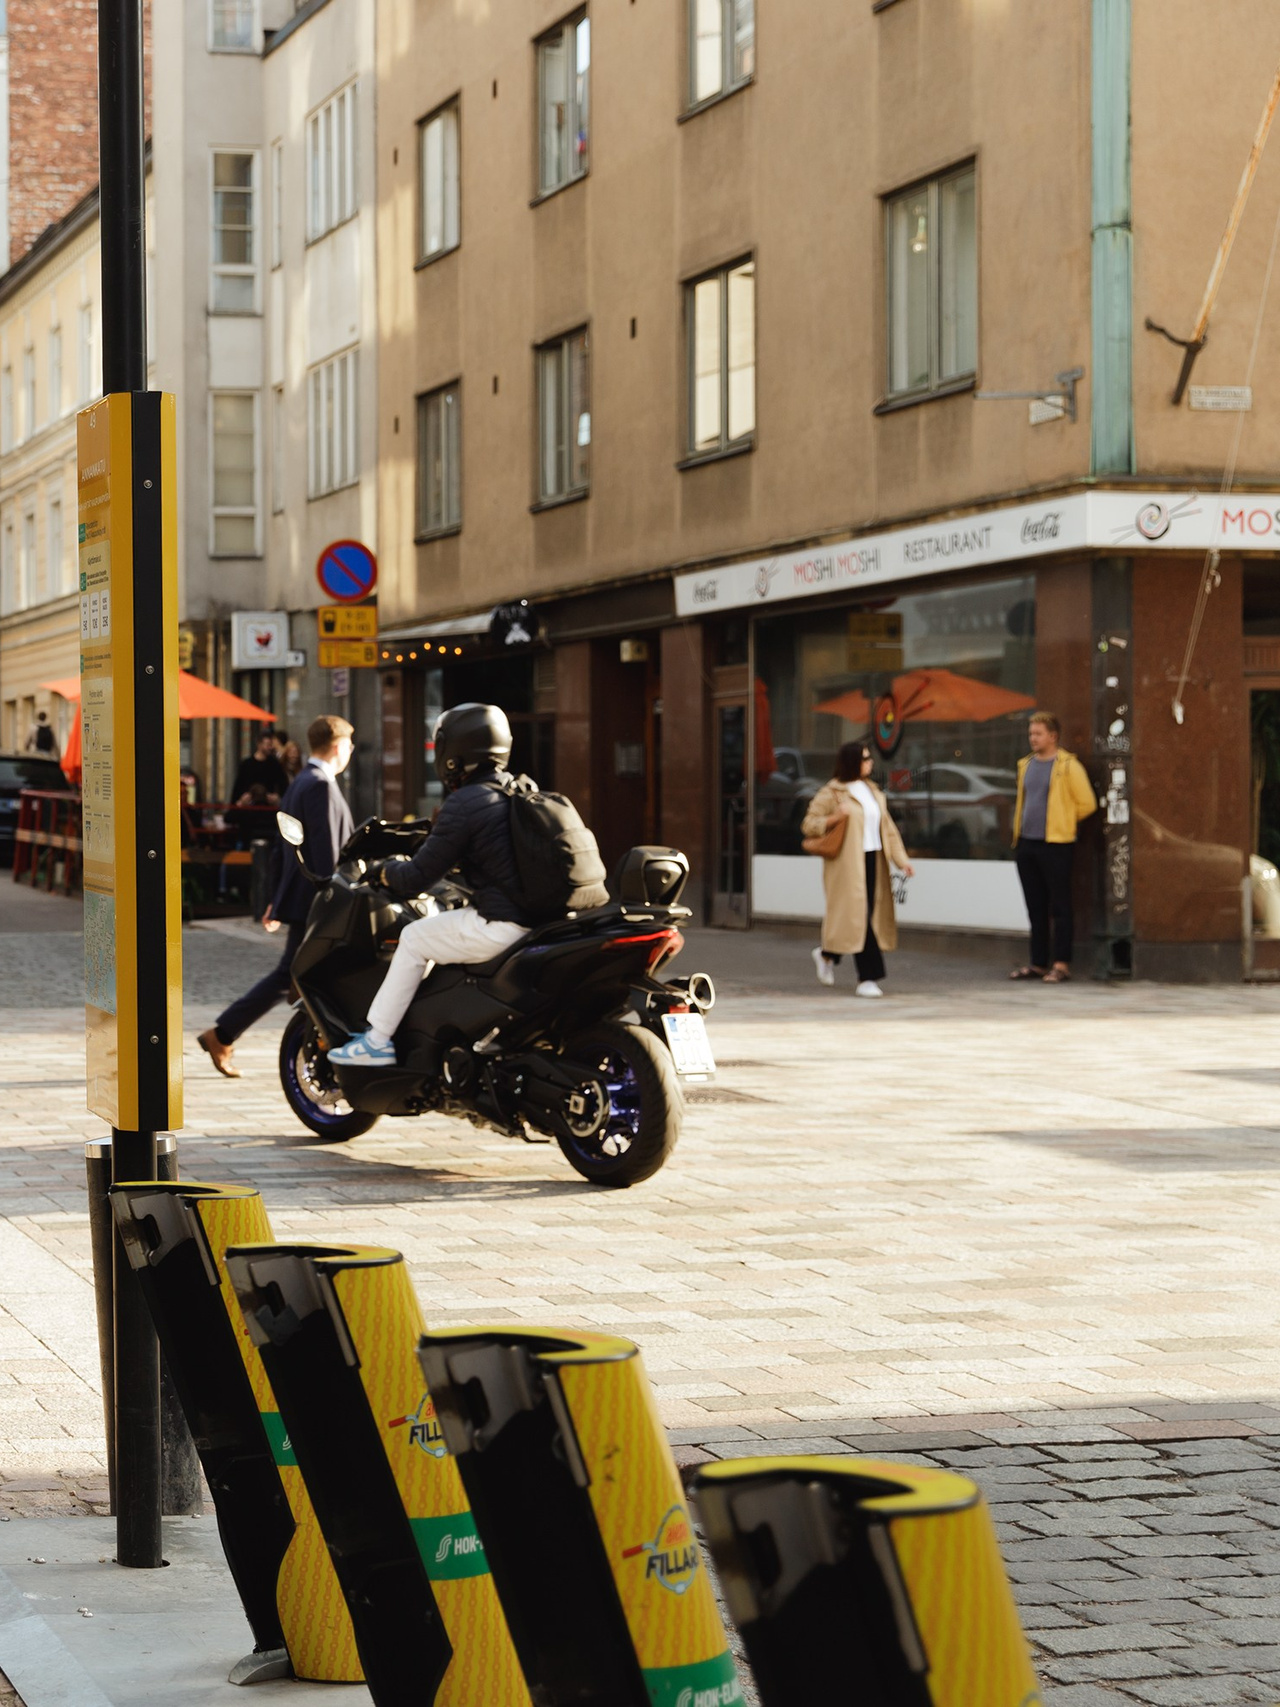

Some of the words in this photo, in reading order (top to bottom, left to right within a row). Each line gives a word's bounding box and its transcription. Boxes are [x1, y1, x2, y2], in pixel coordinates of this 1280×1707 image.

[904, 526, 993, 564] RESTAURANT
[793, 556, 832, 586] MOSHI
[837, 548, 879, 576] MOSHI
